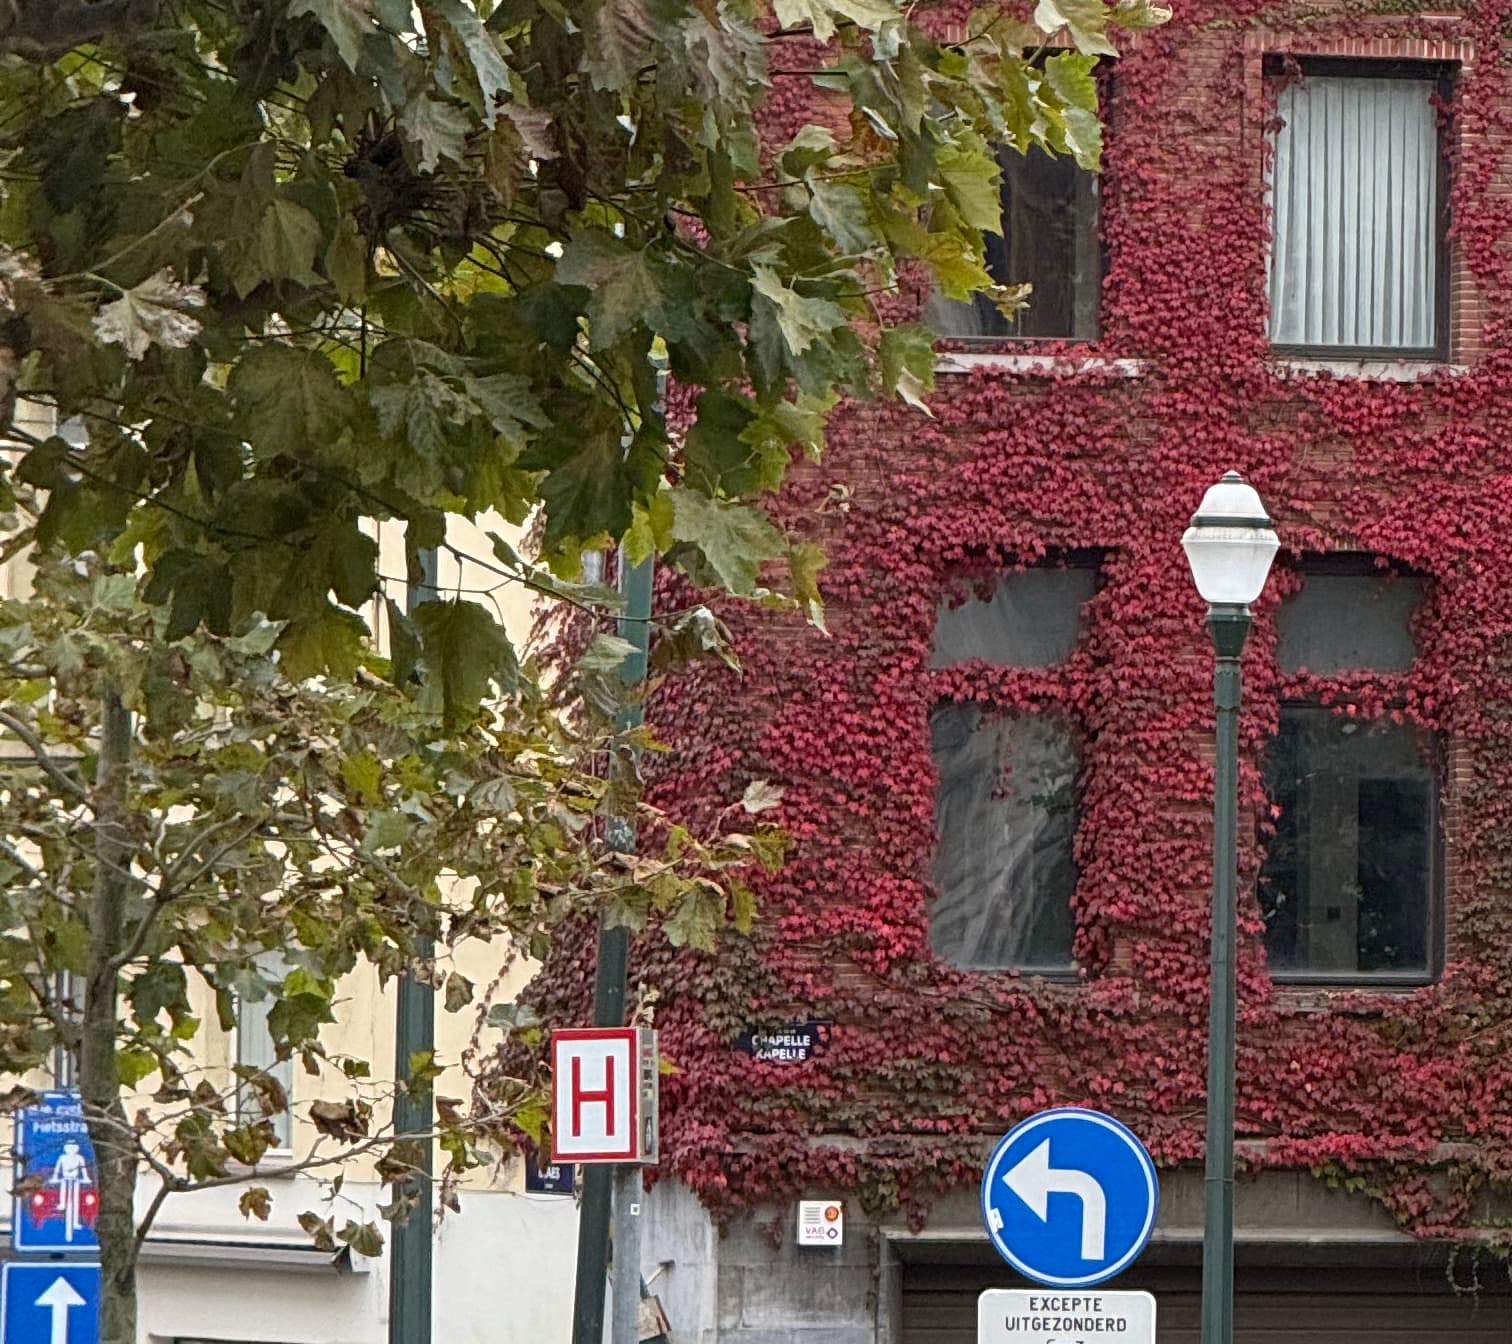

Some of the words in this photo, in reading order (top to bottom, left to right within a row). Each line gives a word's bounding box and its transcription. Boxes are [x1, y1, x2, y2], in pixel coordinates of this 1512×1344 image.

[751, 1035, 811, 1046] CHAPELLE
[571, 1055, 615, 1137] H
[32, 1120, 89, 1134] Fietsstra
[1029, 1297, 1103, 1312] EXCEPTE
[1005, 1317, 1127, 1332] UITGEZONDERD
